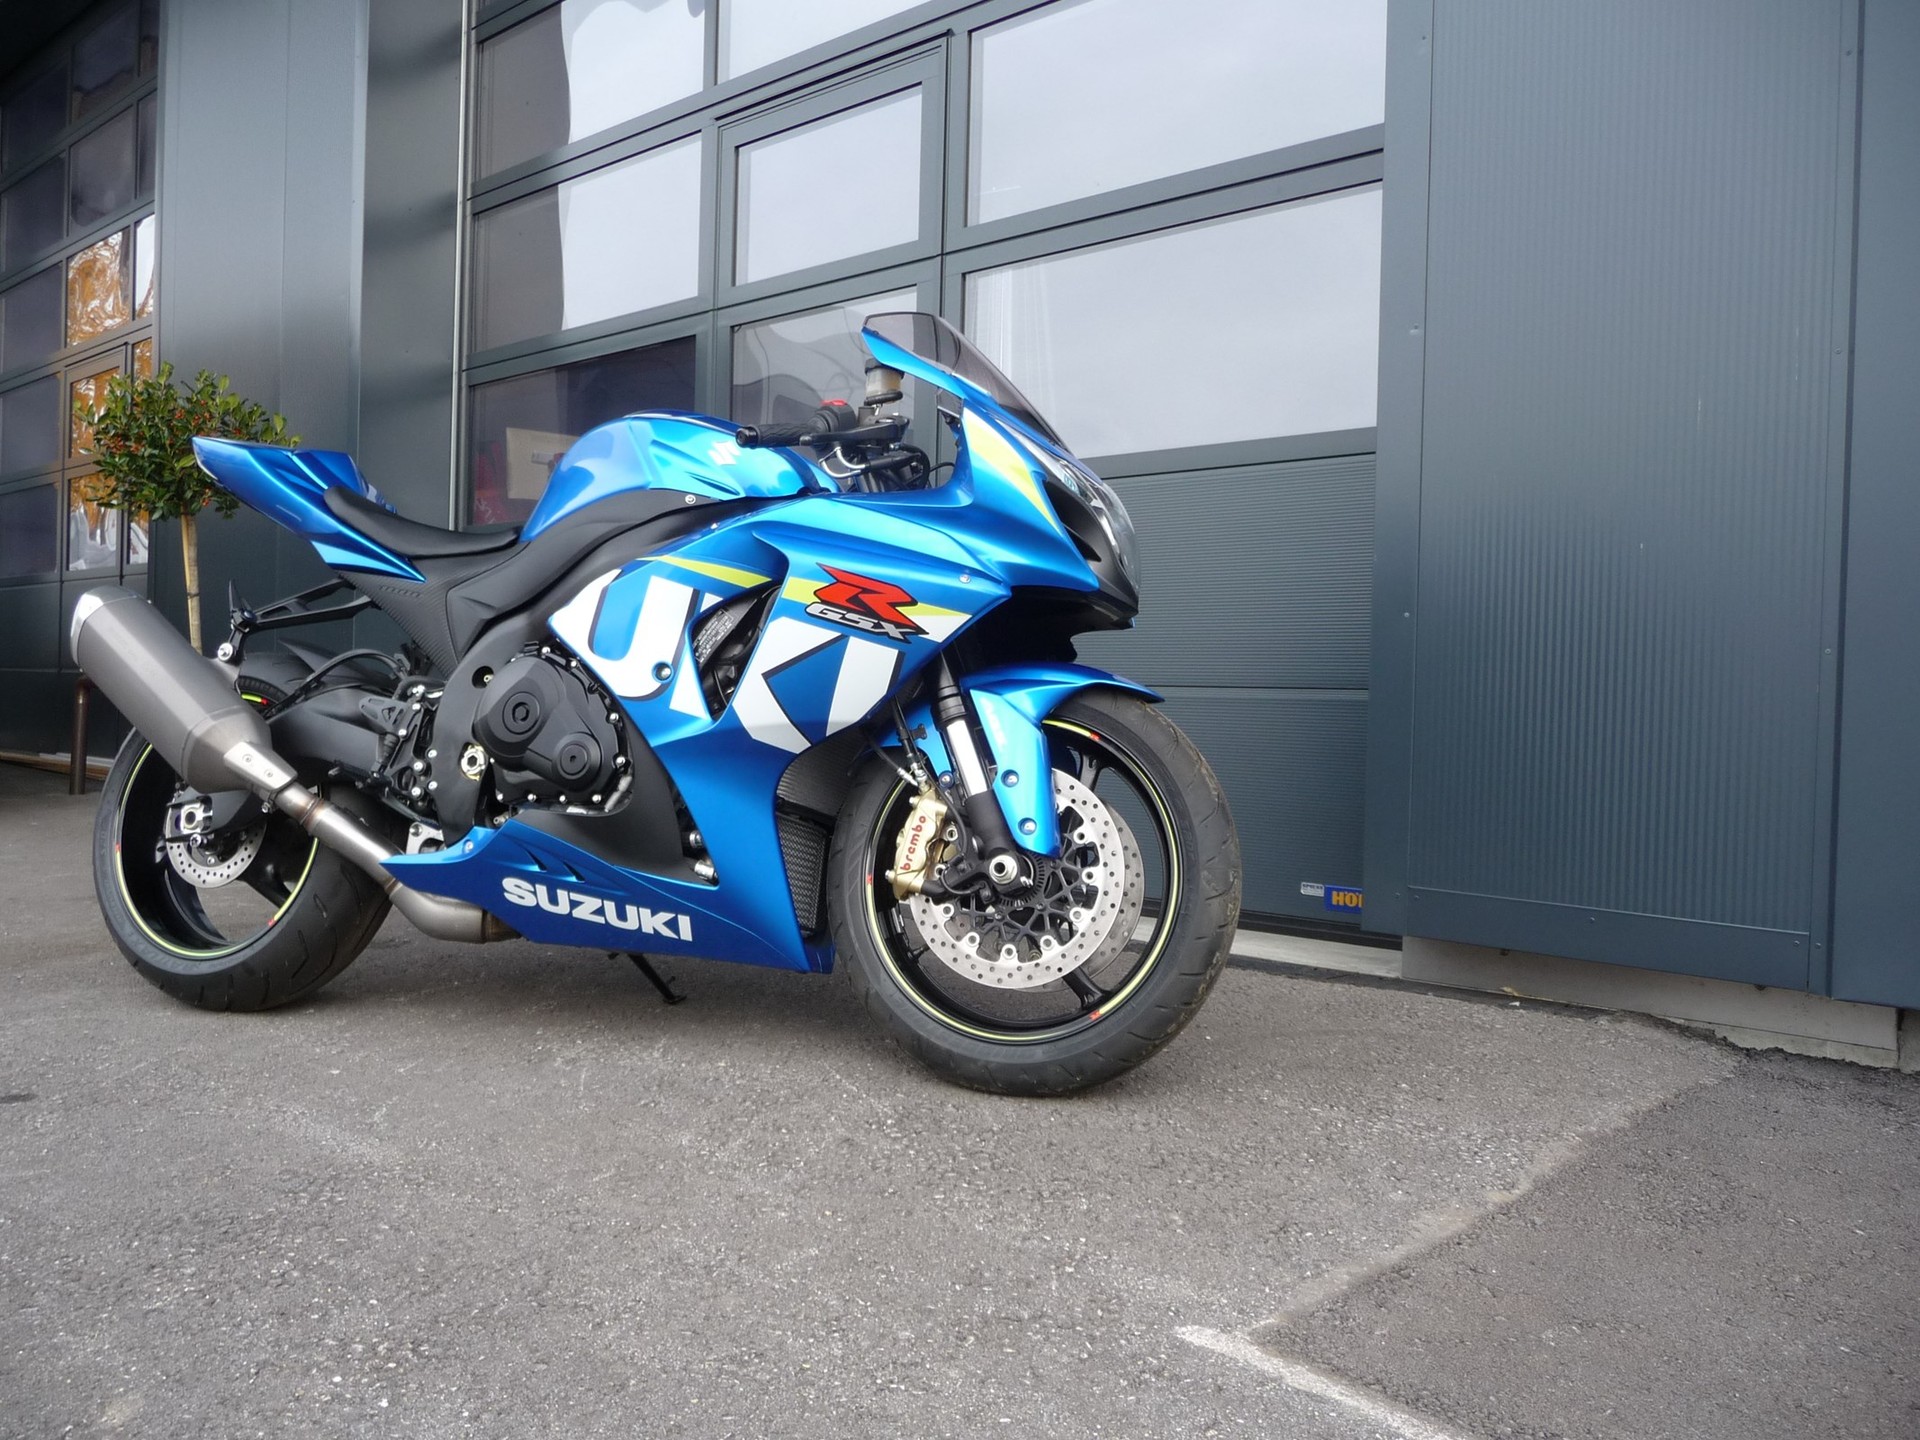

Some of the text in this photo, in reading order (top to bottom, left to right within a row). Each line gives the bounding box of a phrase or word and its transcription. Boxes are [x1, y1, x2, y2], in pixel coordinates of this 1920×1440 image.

[805, 602, 917, 641] GSX
[900, 815, 927, 872] brembo
[501, 876, 693, 942] SUZUKI
